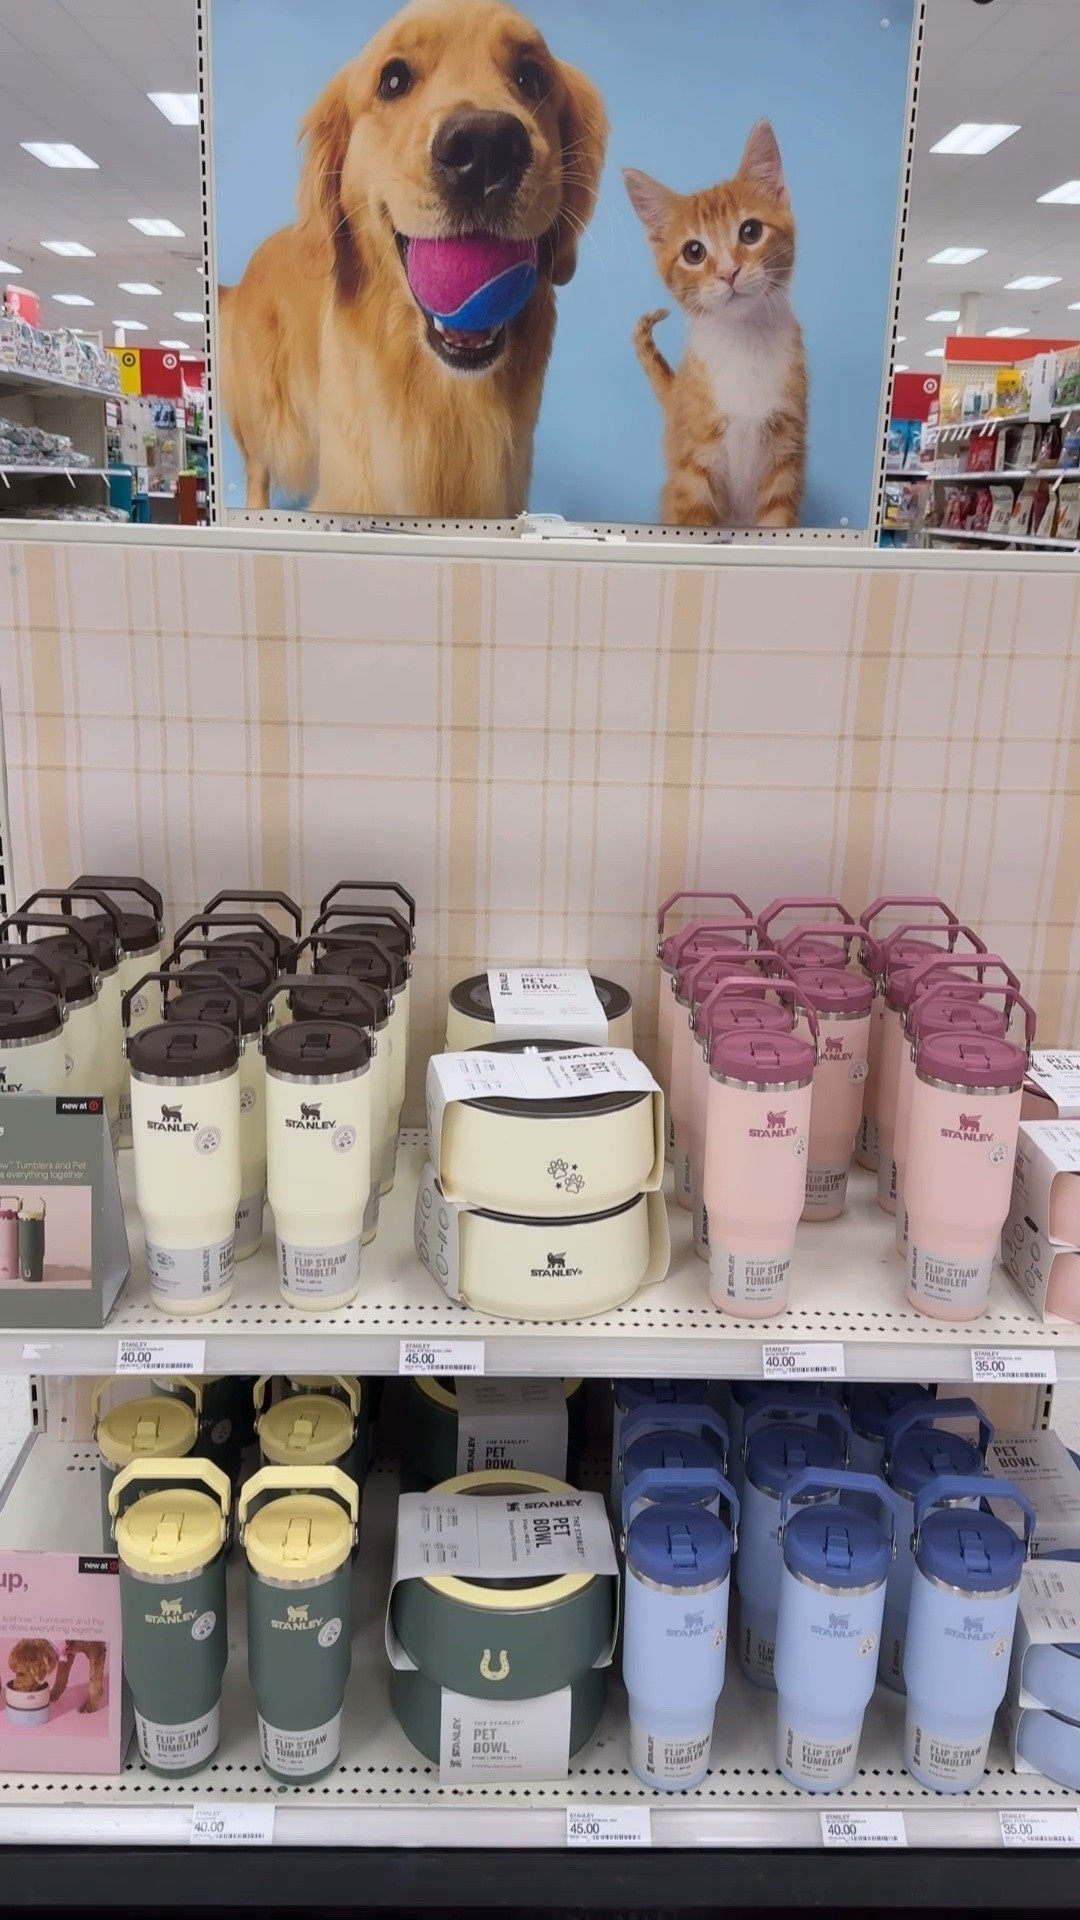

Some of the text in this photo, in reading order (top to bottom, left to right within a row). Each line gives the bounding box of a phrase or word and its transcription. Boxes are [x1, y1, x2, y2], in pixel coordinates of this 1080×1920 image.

[559, 1051, 614, 1060] STANLEY
[820, 1052, 854, 1061] ANLEY
[62, 1102, 87, 1110] new at
[147, 1120, 199, 1132] STANLEY
[285, 1119, 336, 1130] STANLEY
[749, 1126, 798, 1138] STANLEY
[941, 1128, 994, 1142] STANLEY
[55, 1161, 71, 1169] and
[202, 1249, 210, 1283] STANLEY
[294, 1254, 347, 1268] FLIP STRAW
[295, 1267, 337, 1277] TUMBLER
[745, 1259, 790, 1276] FLIP STRAW
[925, 1262, 979, 1278] FLIP STRAW
[745, 1273, 784, 1286] TUMBLER
[925, 1271, 968, 1288] TUMBLER
[121, 1351, 152, 1363] 40.00
[405, 1353, 435, 1364] 45.00
[766, 1356, 796, 1367] 40.00
[975, 1361, 1005, 1371] 35.00
[485, 1447, 506, 1458] PET
[992, 1446, 1018, 1457] PET
[485, 1459, 516, 1470] BOWL
[999, 1457, 1040, 1468] BOWL
[524, 1499, 582, 1509] STANLEY
[552, 1517, 571, 1537] PET
[533, 1518, 552, 1549] BOWL
[84, 1562, 99, 1570] new
[145, 1609, 198, 1624] STANLEY
[271, 1617, 323, 1631] STANLEY
[666, 1621, 715, 1637] STANLEY
[811, 1625, 862, 1638] STANLEY
[944, 1627, 996, 1641] STANLEY
[156, 1734, 175, 1744] FLIP
[178, 1724, 209, 1743] STRAW
[452, 1717, 461, 1757] STANLEY
[473, 1728, 498, 1740] PET
[157, 1739, 199, 1752] TUMBLER
[275, 1738, 294, 1750] FLIP
[297, 1733, 328, 1750] STRAW
[276, 1747, 318, 1758] TUMBLER
[473, 1742, 510, 1754] BOWL
[665, 1748, 684, 1756] FLIP
[802, 1745, 822, 1757] FLIP
[825, 1744, 853, 1758] STRAW
[930, 1744, 950, 1757] FLIP
[953, 1746, 982, 1759] STRAW
[665, 1749, 704, 1765] TUMBLER
[802, 1754, 843, 1766] TUMBLER
[930, 1753, 972, 1767] TUMBLER
[194, 1821, 224, 1833] 40.00
[570, 1823, 600, 1834] 45.00
[827, 1824, 857, 1836] 40.00
[1004, 1823, 1033, 1835] 35.00
